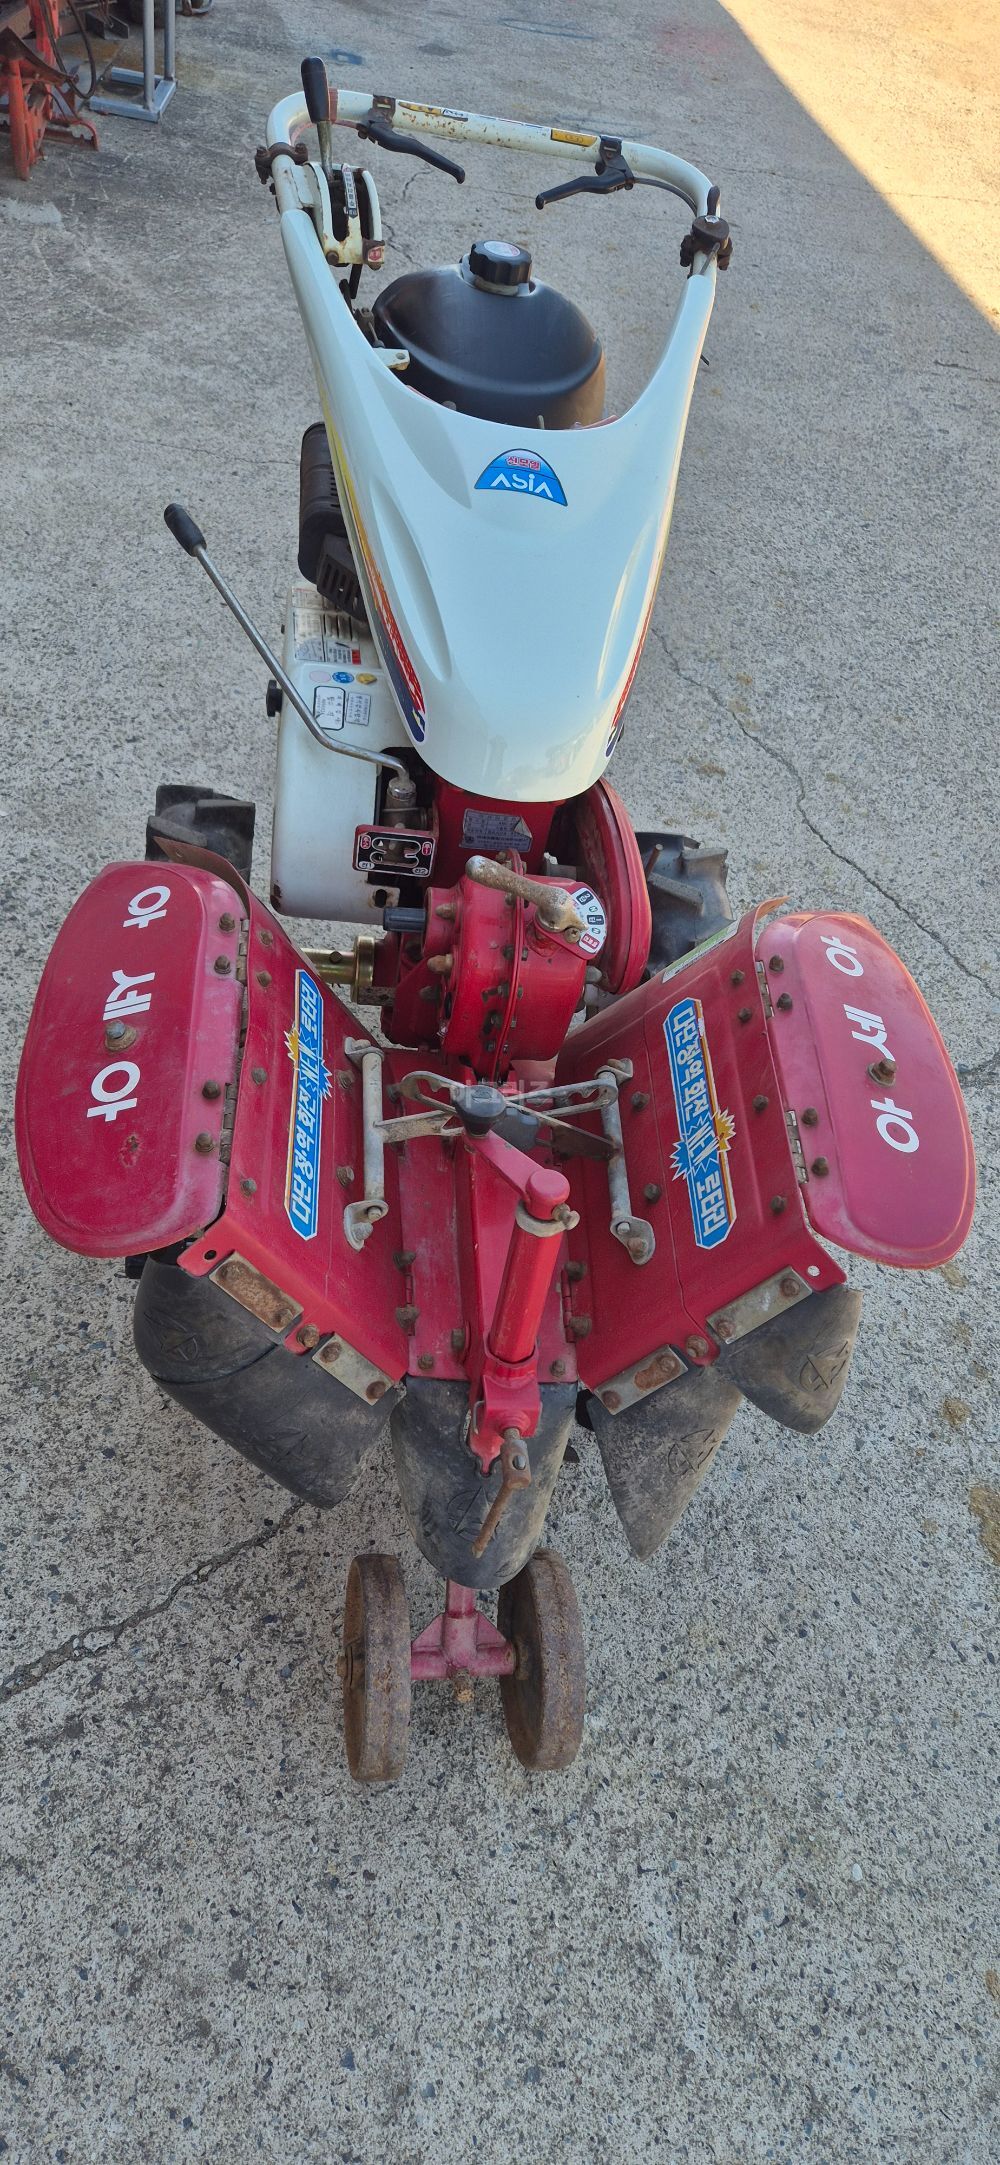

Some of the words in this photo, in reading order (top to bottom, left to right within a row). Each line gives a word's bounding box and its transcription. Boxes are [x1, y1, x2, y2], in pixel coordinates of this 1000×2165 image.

[300, 979, 318, 1039] 로타리
[297, 1039, 319, 1091] NEW
[686, 1121, 719, 1170] NEW
[697, 1171, 728, 1237] 로타리
